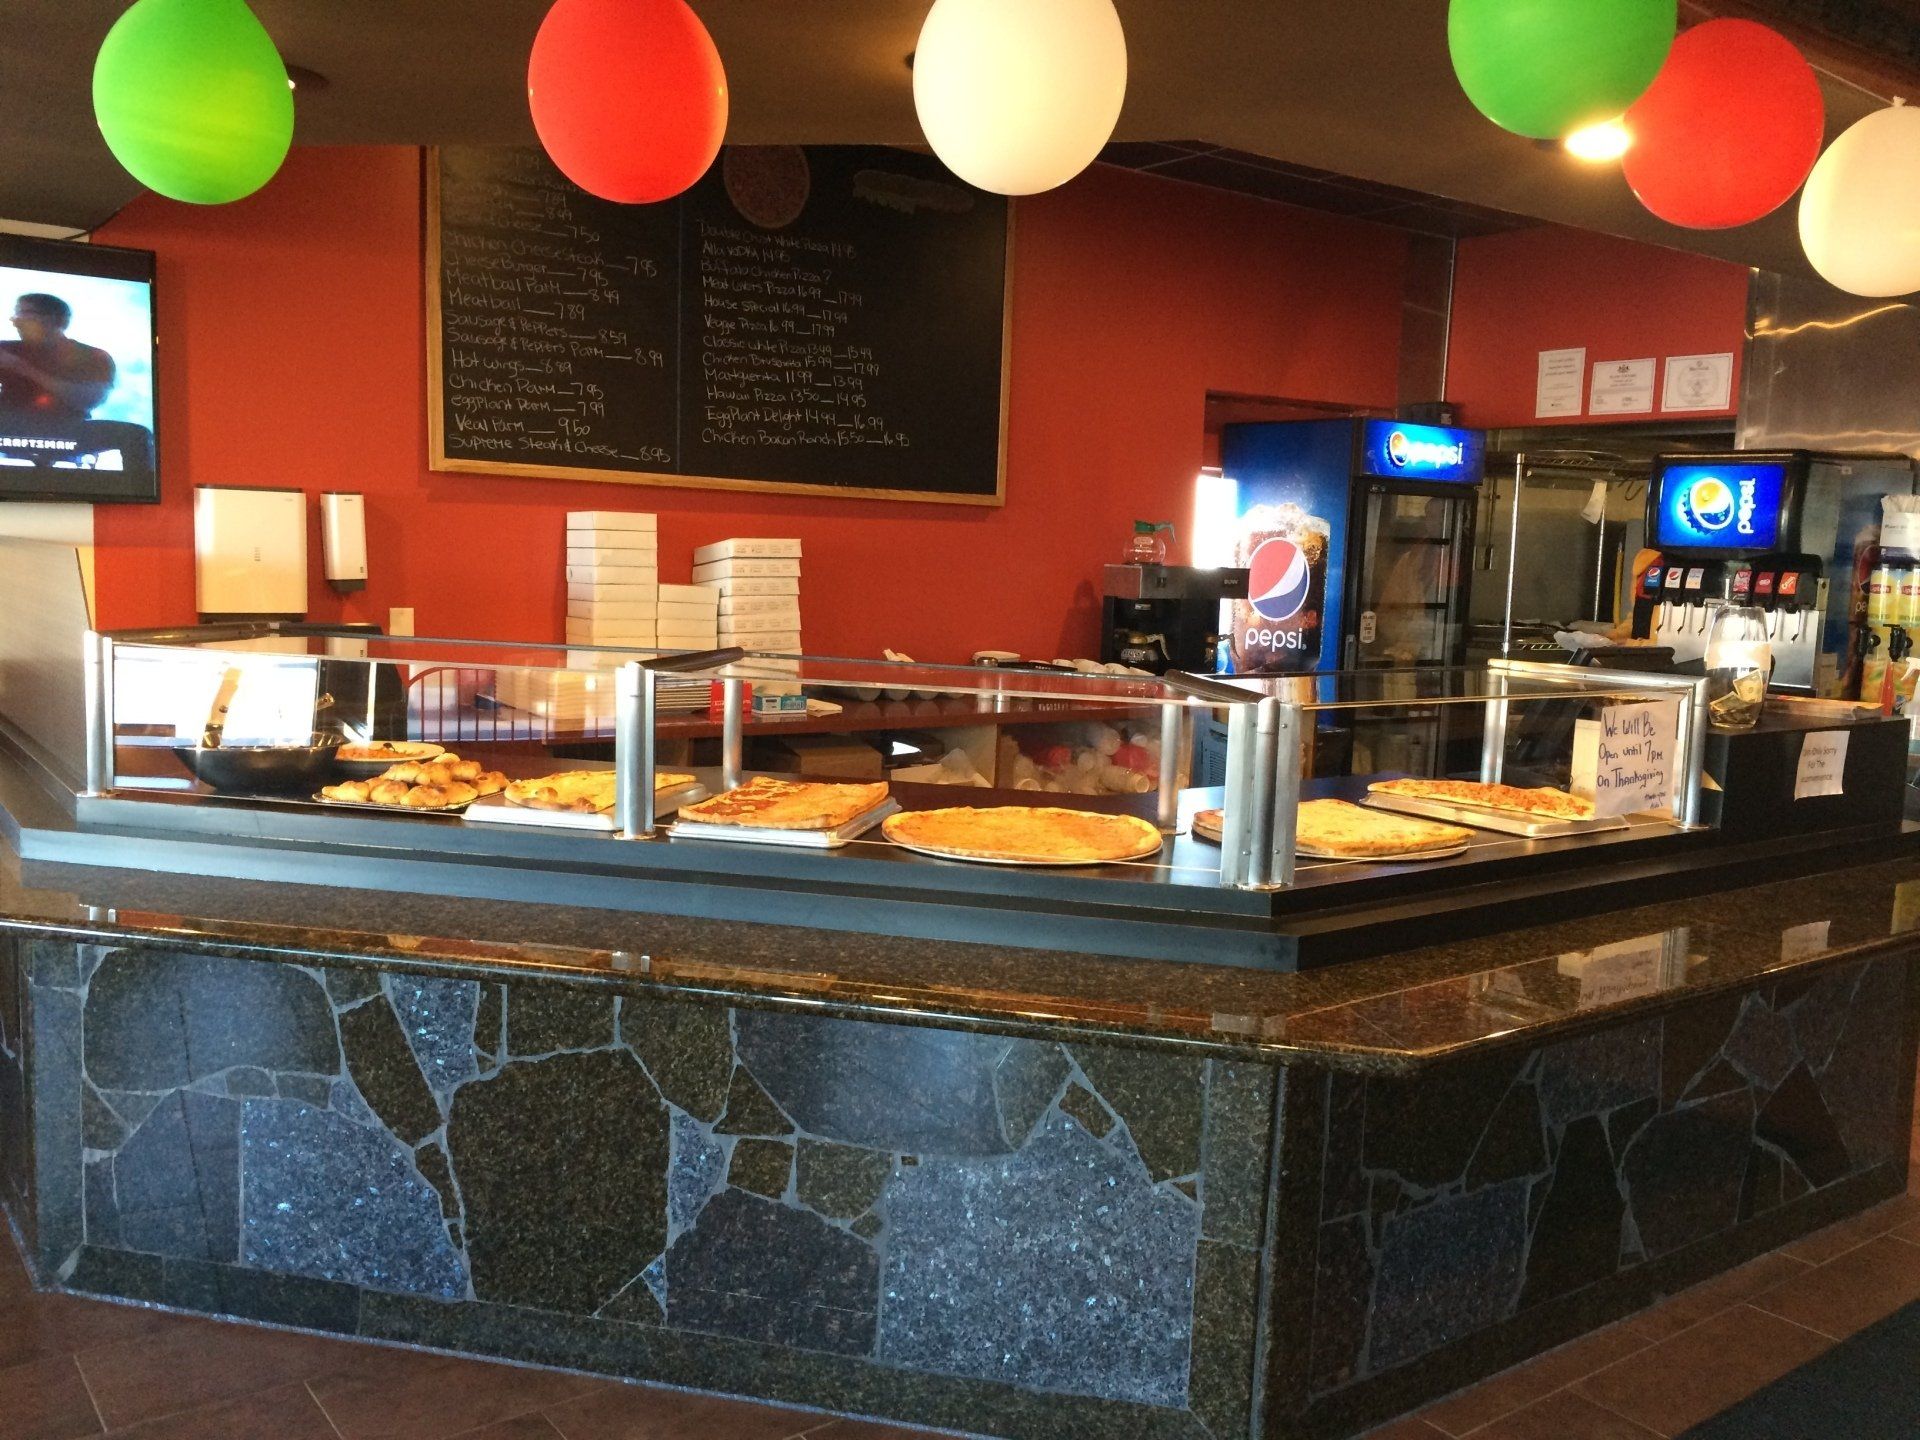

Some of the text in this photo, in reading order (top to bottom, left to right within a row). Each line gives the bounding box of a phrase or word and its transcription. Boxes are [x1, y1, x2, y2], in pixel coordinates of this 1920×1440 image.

[446, 267, 521, 291] Meatball
[449, 287, 520, 309] Meatball
[445, 309, 506, 335] Sausage
[447, 327, 507, 352] Sausage
[452, 347, 479, 368] Hot
[449, 373, 512, 393] Chicken
[753, 387, 787, 402] Pizza
[454, 413, 488, 432] Veal
[1737, 478, 1756, 534] pepsi
[1244, 627, 1303, 653] pepsi
[1603, 711, 1617, 737] We
[1643, 710, 1656, 738] Be
[1598, 742, 1618, 765] Open
[1611, 767, 1664, 789] Thanksgiving
